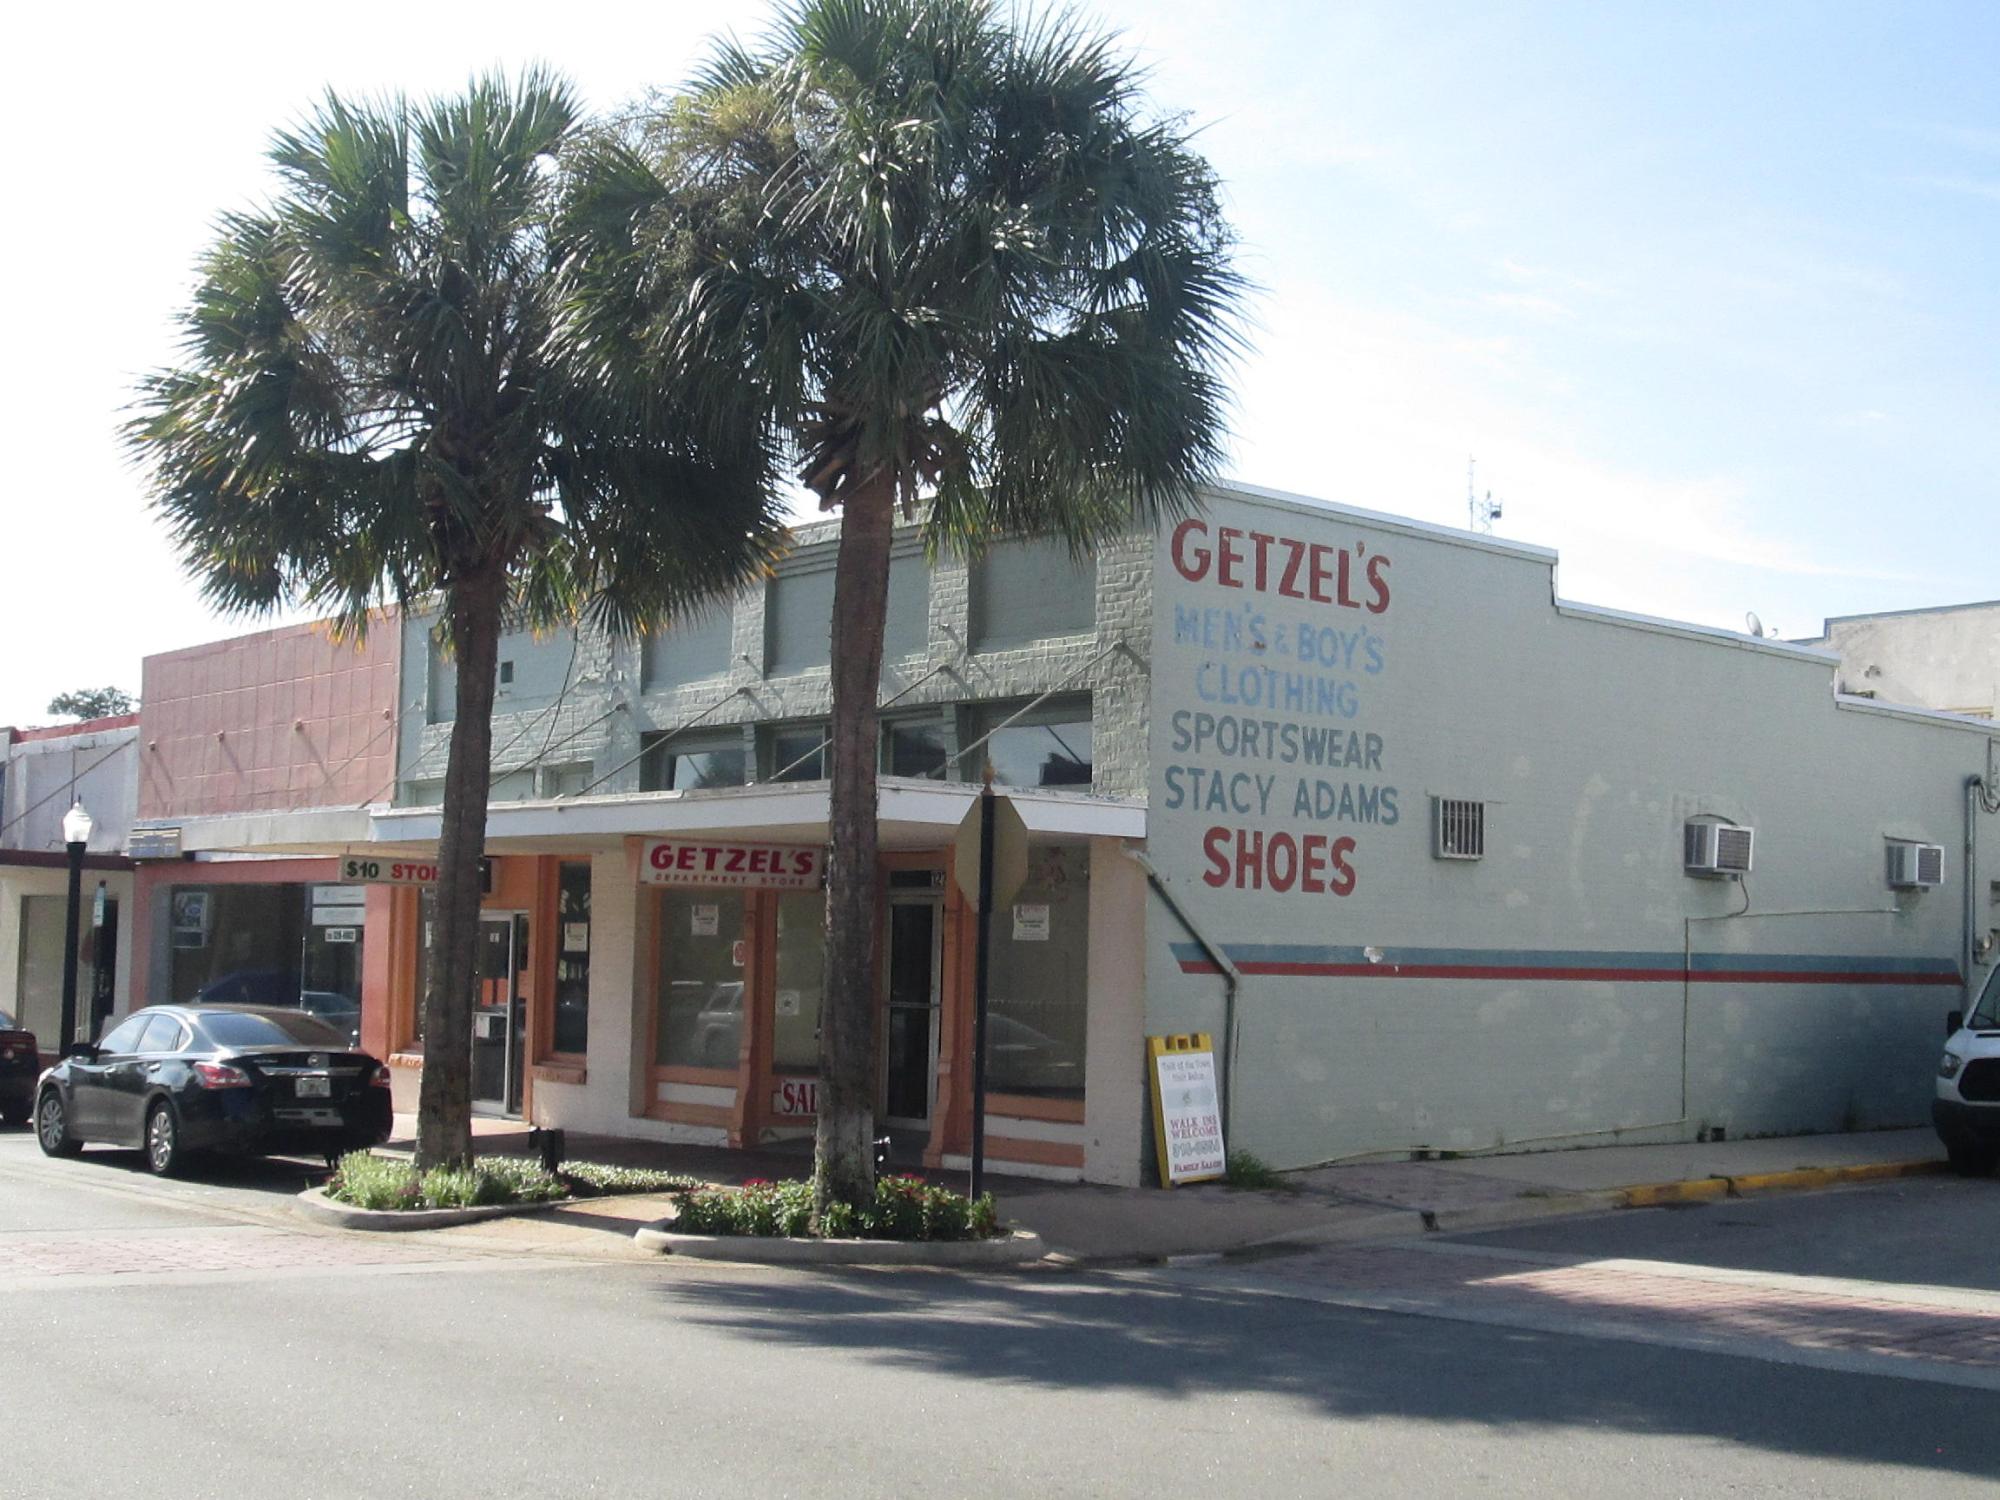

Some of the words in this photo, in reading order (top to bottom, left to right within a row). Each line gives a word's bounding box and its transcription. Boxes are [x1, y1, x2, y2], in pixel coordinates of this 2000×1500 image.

[1171, 518, 1391, 614] GETZEL'S
[1174, 602, 1266, 652] MEN'S
[1274, 624, 1290, 655] &
[1297, 622, 1386, 676] BOY'S
[1196, 661, 1360, 719] CLOTHING
[1171, 709, 1384, 771] SPORTSWEAR
[1164, 765, 1275, 818] STACY
[1292, 778, 1400, 826] ADAMS
[347, 861, 379, 878] $10
[391, 864, 438, 880] STO
[650, 844, 813, 876] GETZEL'S
[655, 873, 746, 884] DEPARTMENT
[761, 877, 804, 886] STORE
[1203, 826, 1357, 897] SHOES
[783, 1083, 816, 1113] SAL
[1170, 1117, 1198, 1128] WALK
